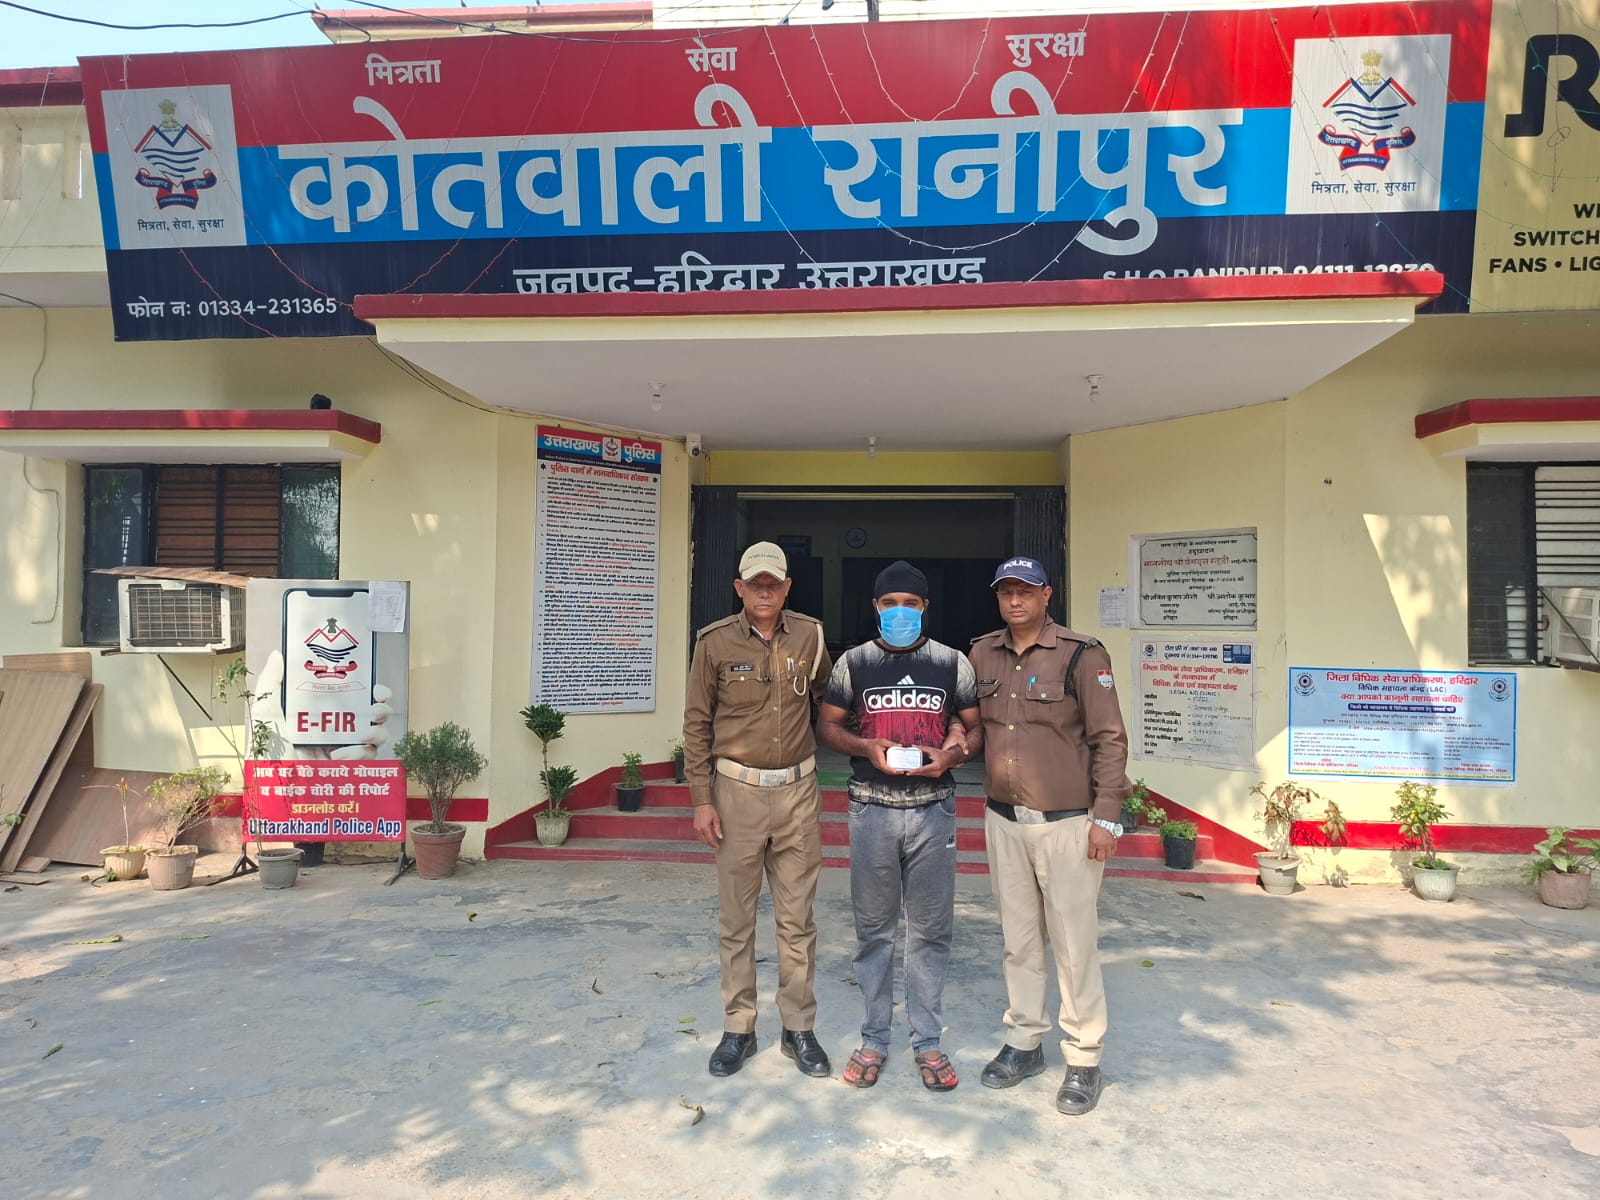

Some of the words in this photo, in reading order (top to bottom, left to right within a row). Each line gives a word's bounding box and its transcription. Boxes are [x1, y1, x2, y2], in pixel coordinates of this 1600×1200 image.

[685, 38, 738, 73] सेवा
[1005, 31, 1087, 68] सुरक्षा
[365, 53, 442, 86] मित्रता
[278, 83, 773, 233] कोतवाली
[812, 71, 1244, 256] रानीपुर
[1311, 180, 1349, 194] मित्रता,
[1353, 180, 1379, 194] सेवा,
[1384, 181, 1416, 196] सुरक्षा
[197, 218, 224, 232] सुरक्षा
[1513, 231, 1600, 246] SWITCH
[1489, 257, 1547, 273] FANS
[127, 296, 165, 318] फोन
[199, 297, 338, 316] 01334-231365
[544, 434, 601, 453] उत्तराखण्ड
[624, 442, 656, 463] पुलिस
[1003, 559, 1032, 570] POLICE
[1326, 672, 1349, 681] जिला
[1352, 673, 1379, 682] विधिक
[1383, 674, 1399, 683] सेवा
[1449, 675, 1479, 686] हरिद्वार
[1358, 683, 1379, 691] विधिक
[867, 689, 942, 710] adidas
[297, 711, 356, 733] E-FIR
[337, 783, 356, 796] की
[291, 801, 335, 814] डाउनलोड
[249, 818, 330, 836] Uttarakhand
[333, 818, 373, 834] Police
[376, 818, 401, 838] App
